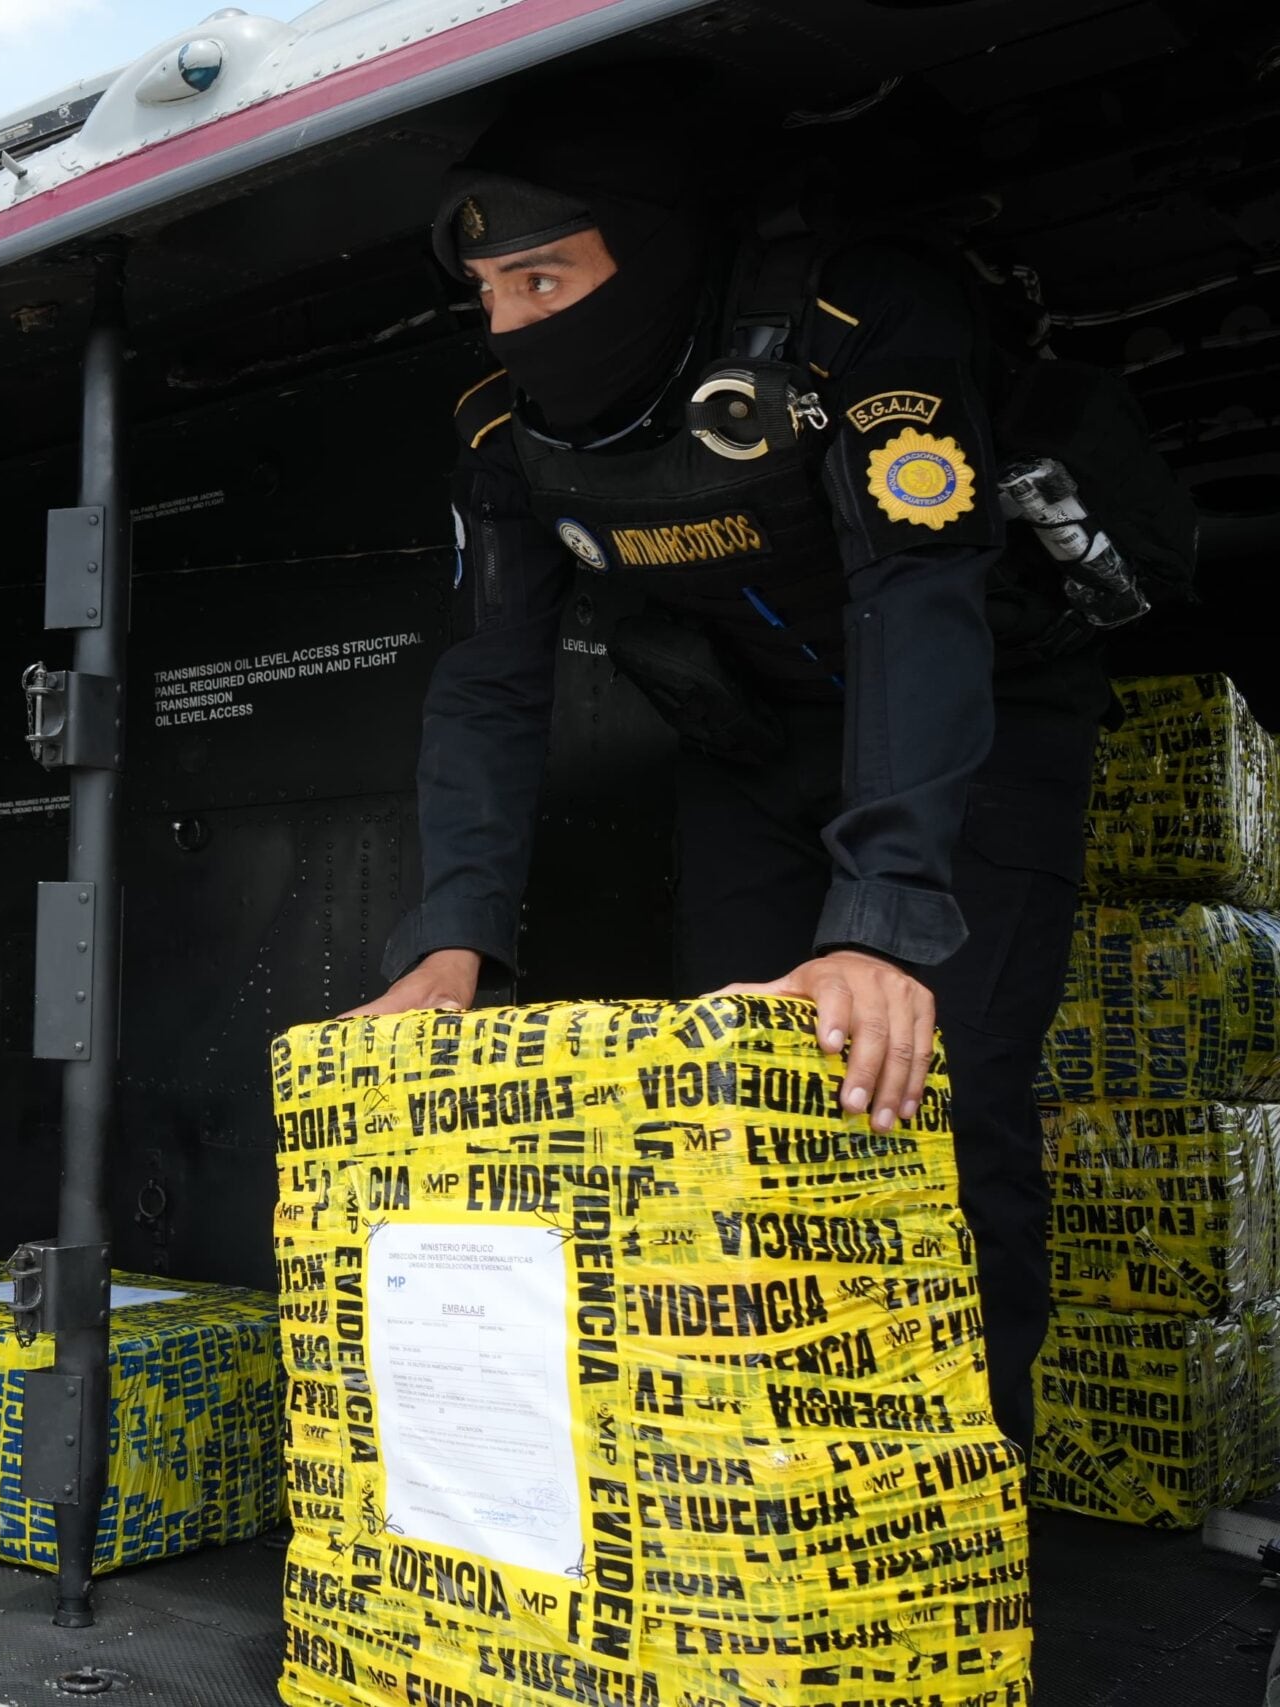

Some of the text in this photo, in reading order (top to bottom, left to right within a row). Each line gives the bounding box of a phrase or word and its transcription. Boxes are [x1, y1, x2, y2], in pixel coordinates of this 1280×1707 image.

[856, 398, 929, 424] S.G.A.I.A.
[612, 515, 761, 565] ANTINARCOTICOS
[154, 632, 424, 683] TRANSMISSION OIL LEVEL ACCESS STRUCTURAL
[562, 638, 588, 653] LEVEL
[154, 652, 397, 698] PANEL REQUIRED GROUND RUN AND FLIGHT
[155, 691, 233, 712] TRANSMISSION
[155, 703, 253, 727] OIL LEVEL ACCESS
[1101, 934, 1138, 1097] EVIDENCIA
[408, 1075, 619, 1138] EVIDENCIA MP
[638, 1062, 844, 1120] EVIDENCIA
[684, 1128, 732, 1151] MP
[426, 1173, 459, 1194] MP
[712, 1211, 942, 1265] EVIDENCIA MP
[387, 1275, 406, 1288] MP
[626, 1276, 828, 1337] EVIDENCIA
[442, 1303, 485, 1314] EMBALAJE
[887, 1318, 921, 1348] MP
[334, 1246, 379, 1463] EVIDENCIA
[767, 1383, 955, 1434] EVIDENCIA
[1042, 1374, 1194, 1424] EVIDENCIA
[130, 1405, 148, 1462] MP
[170, 1426, 188, 1482] MP
[595, 1411, 617, 1466] MP
[362, 1488, 376, 1535] MP
[637, 1485, 859, 1536] EVIDENCIA
[388, 1543, 512, 1621] IDENCIA
[520, 1588, 558, 1616] MP
[478, 1645, 660, 1707] EVIDENCIA
